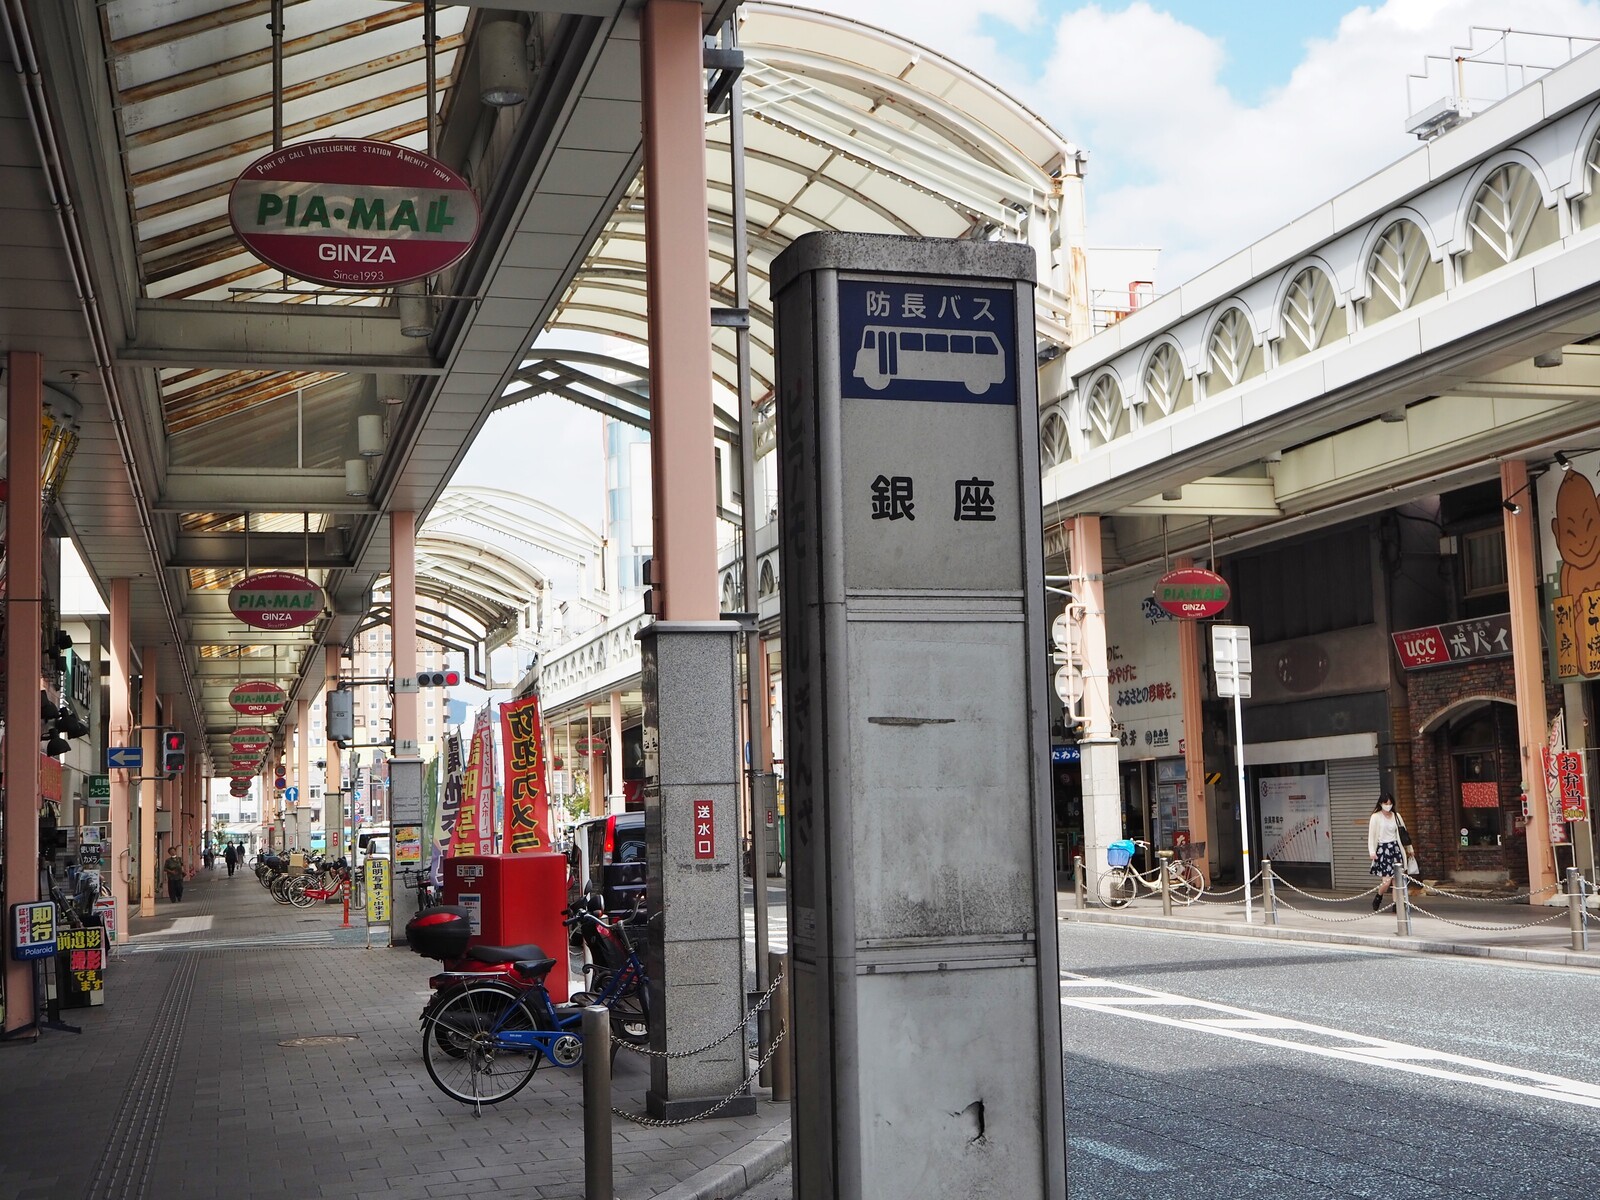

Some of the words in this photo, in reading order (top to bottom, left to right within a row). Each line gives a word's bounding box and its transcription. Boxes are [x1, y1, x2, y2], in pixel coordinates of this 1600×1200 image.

[318, 243, 396, 264] GINZA
[866, 290, 995, 322] 防長バス
[261, 612, 293, 621] GINZA
[1182, 603, 1206, 611] GINZA
[1449, 627, 1509, 657] ポパイ
[1416, 656, 1436, 665] コーヒー
[1562, 755, 1581, 808] お弁当
[697, 805, 711, 853] 送水口
[25, 945, 53, 956] Polaroid
